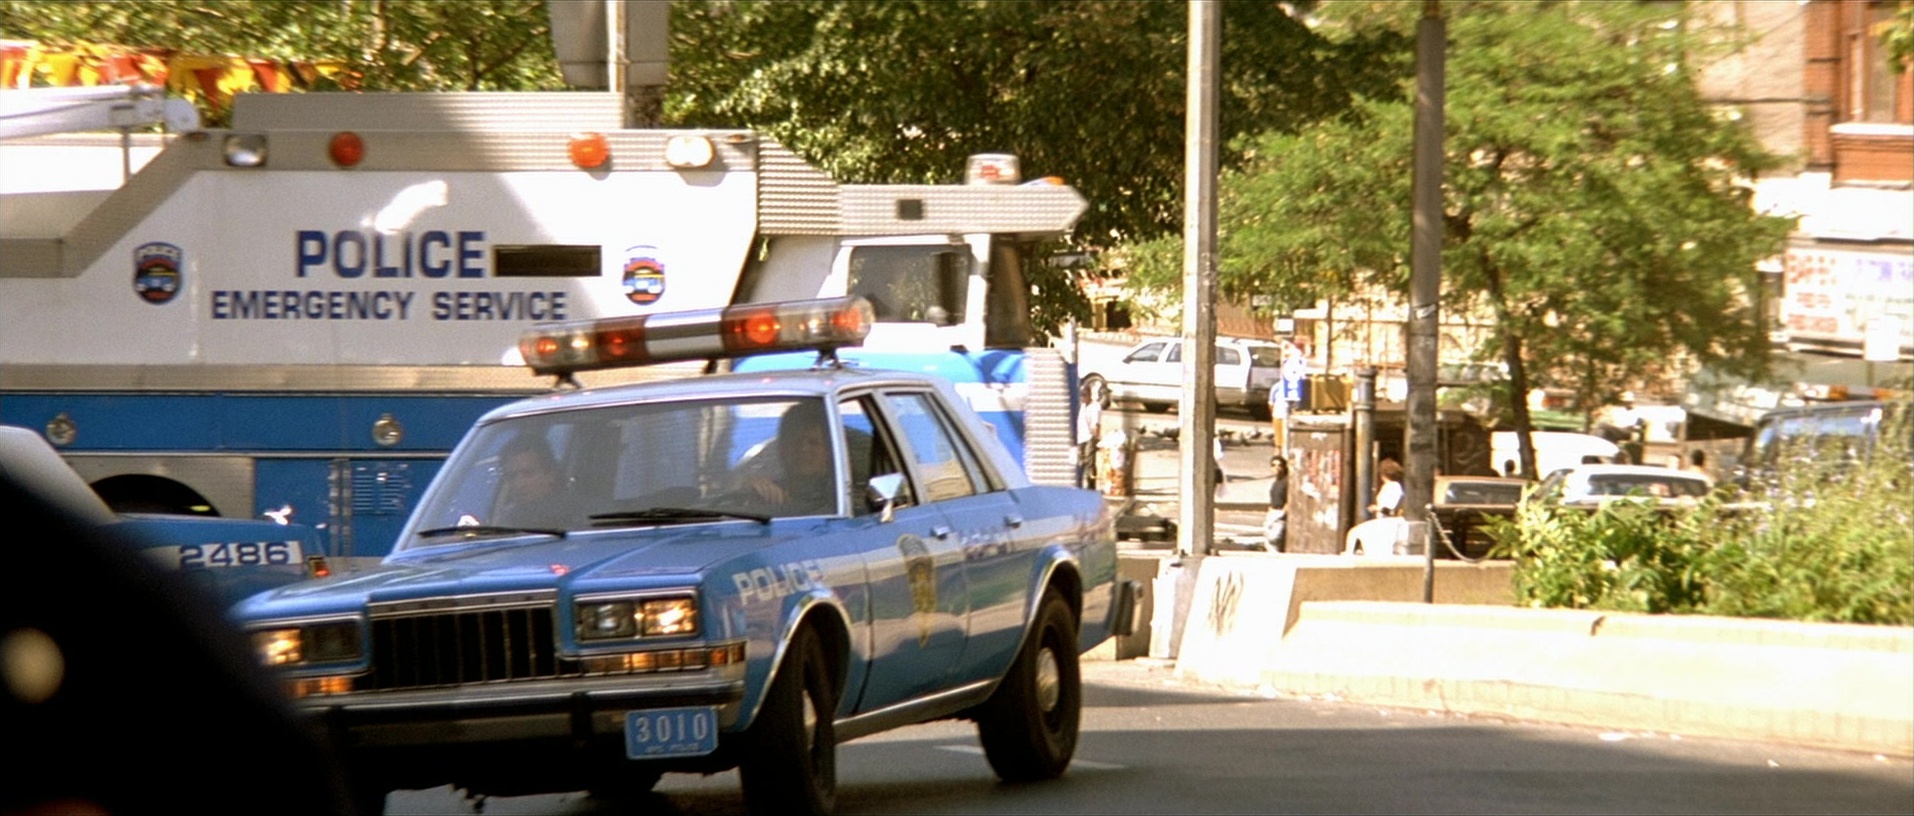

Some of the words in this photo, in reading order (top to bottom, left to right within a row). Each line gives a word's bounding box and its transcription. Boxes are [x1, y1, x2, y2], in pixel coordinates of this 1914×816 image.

[295, 230, 486, 279] POLICE
[211, 290, 415, 320] EMERGENCY
[432, 290, 568, 320] SERVICE
[179, 541, 290, 572] 2486
[731, 560, 822, 606] POLICE
[635, 713, 708, 742] 3010
